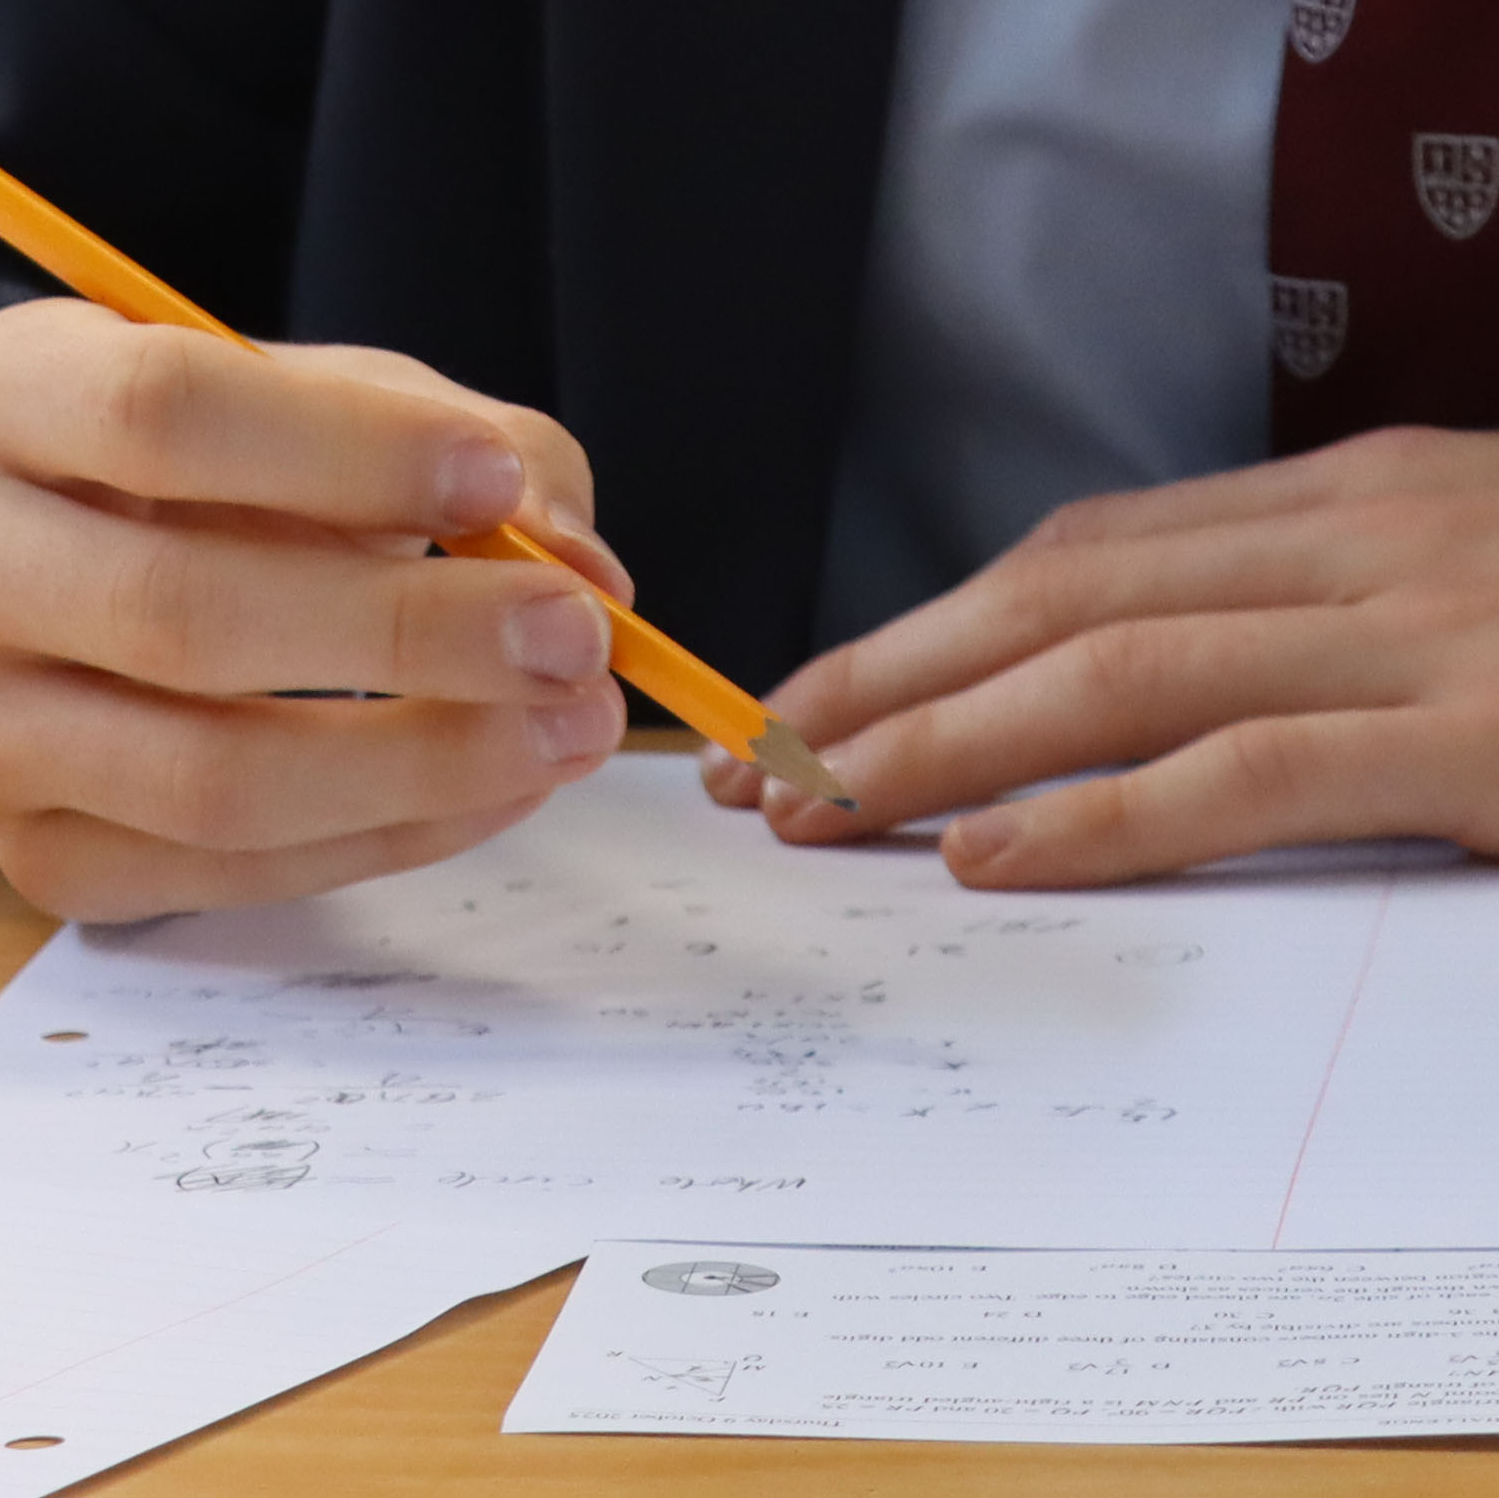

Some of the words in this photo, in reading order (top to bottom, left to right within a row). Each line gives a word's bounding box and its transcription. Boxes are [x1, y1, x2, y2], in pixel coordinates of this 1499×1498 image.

[1241, 1275, 1284, 1283] two
[1291, 1276, 1326, 1284] the
[1333, 1274, 1427, 1283] between
[1237, 1286, 1325, 1294] vertices
[1333, 1286, 1369, 1295] the
[1376, 1285, 1465, 1295] through
[831, 1294, 881, 1302] with
[889, 1294, 963, 1303] circles
[969, 1293, 1016, 1302] Two
[1124, 1292, 1179, 1302] edge
[1184, 1293, 1260, 1302] placed
[1353, 1294, 1399, 1303] side
[1438, 1292, 1491, 1300] each
[1226, 1322, 1252, 1332] by
[1260, 1322, 1361, 1333] divisible
[1367, 1320, 1403, 1328] are
[900, 1334, 945, 1344] odd
[950, 1335, 1050, 1345] different
[1056, 1335, 1114, 1345] three
[1153, 1333, 1271, 1345] consisting
[1277, 1332, 1379, 1342] numbers
[1371, 1380, 1463, 1392] triangle
[822, 1393, 914, 1403] triangle
[1358, 1392, 1399, 1400] lies
[922, 1396, 1072, 1407] right-angled
[1134, 1398, 1204, 1408] PNM
[1214, 1397, 1259, 1407] and
[932, 1405, 977, 1413] and
[1273, 1404, 1327, 1413] with
[568, 1410, 621, 1420] 2025
[631, 1413, 717, 1424] October
[744, 1415, 841, 1428] Thursday
